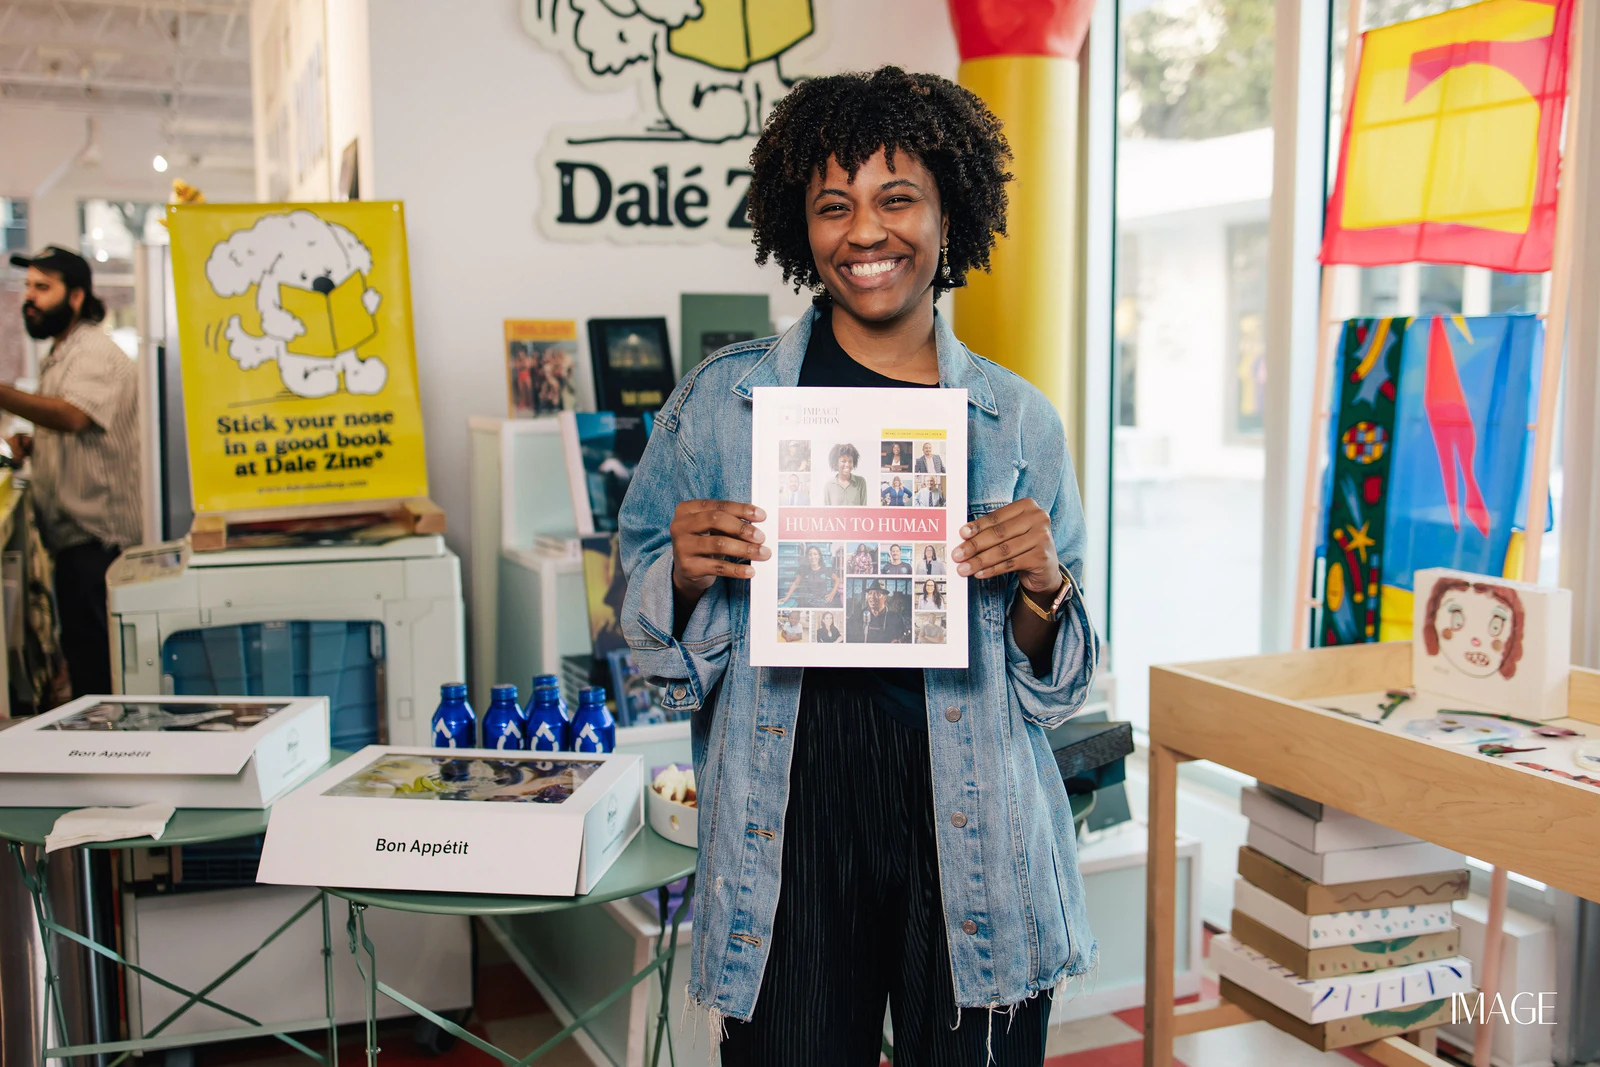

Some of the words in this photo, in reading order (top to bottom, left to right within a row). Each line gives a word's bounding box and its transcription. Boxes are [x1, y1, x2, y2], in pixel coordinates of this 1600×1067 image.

[555, 161, 708, 228] Dalé
[803, 407, 840, 416] IMPACT
[803, 416, 840, 425] EDITION
[217, 414, 277, 434] Stick
[285, 412, 335, 432] your
[344, 410, 393, 426] nose
[225, 437, 246, 455] in
[256, 441, 267, 454] a
[275, 432, 329, 455] good
[336, 429, 392, 447] book
[235, 461, 256, 476] at
[265, 456, 316, 475] Dale
[786, 517, 846, 532] HUMAN
[851, 517, 874, 532] TO
[878, 518, 939, 532] HUMAN
[68, 749, 96, 757] Bon
[376, 838, 406, 853] Bon
[410, 839, 469, 856] Appétit
